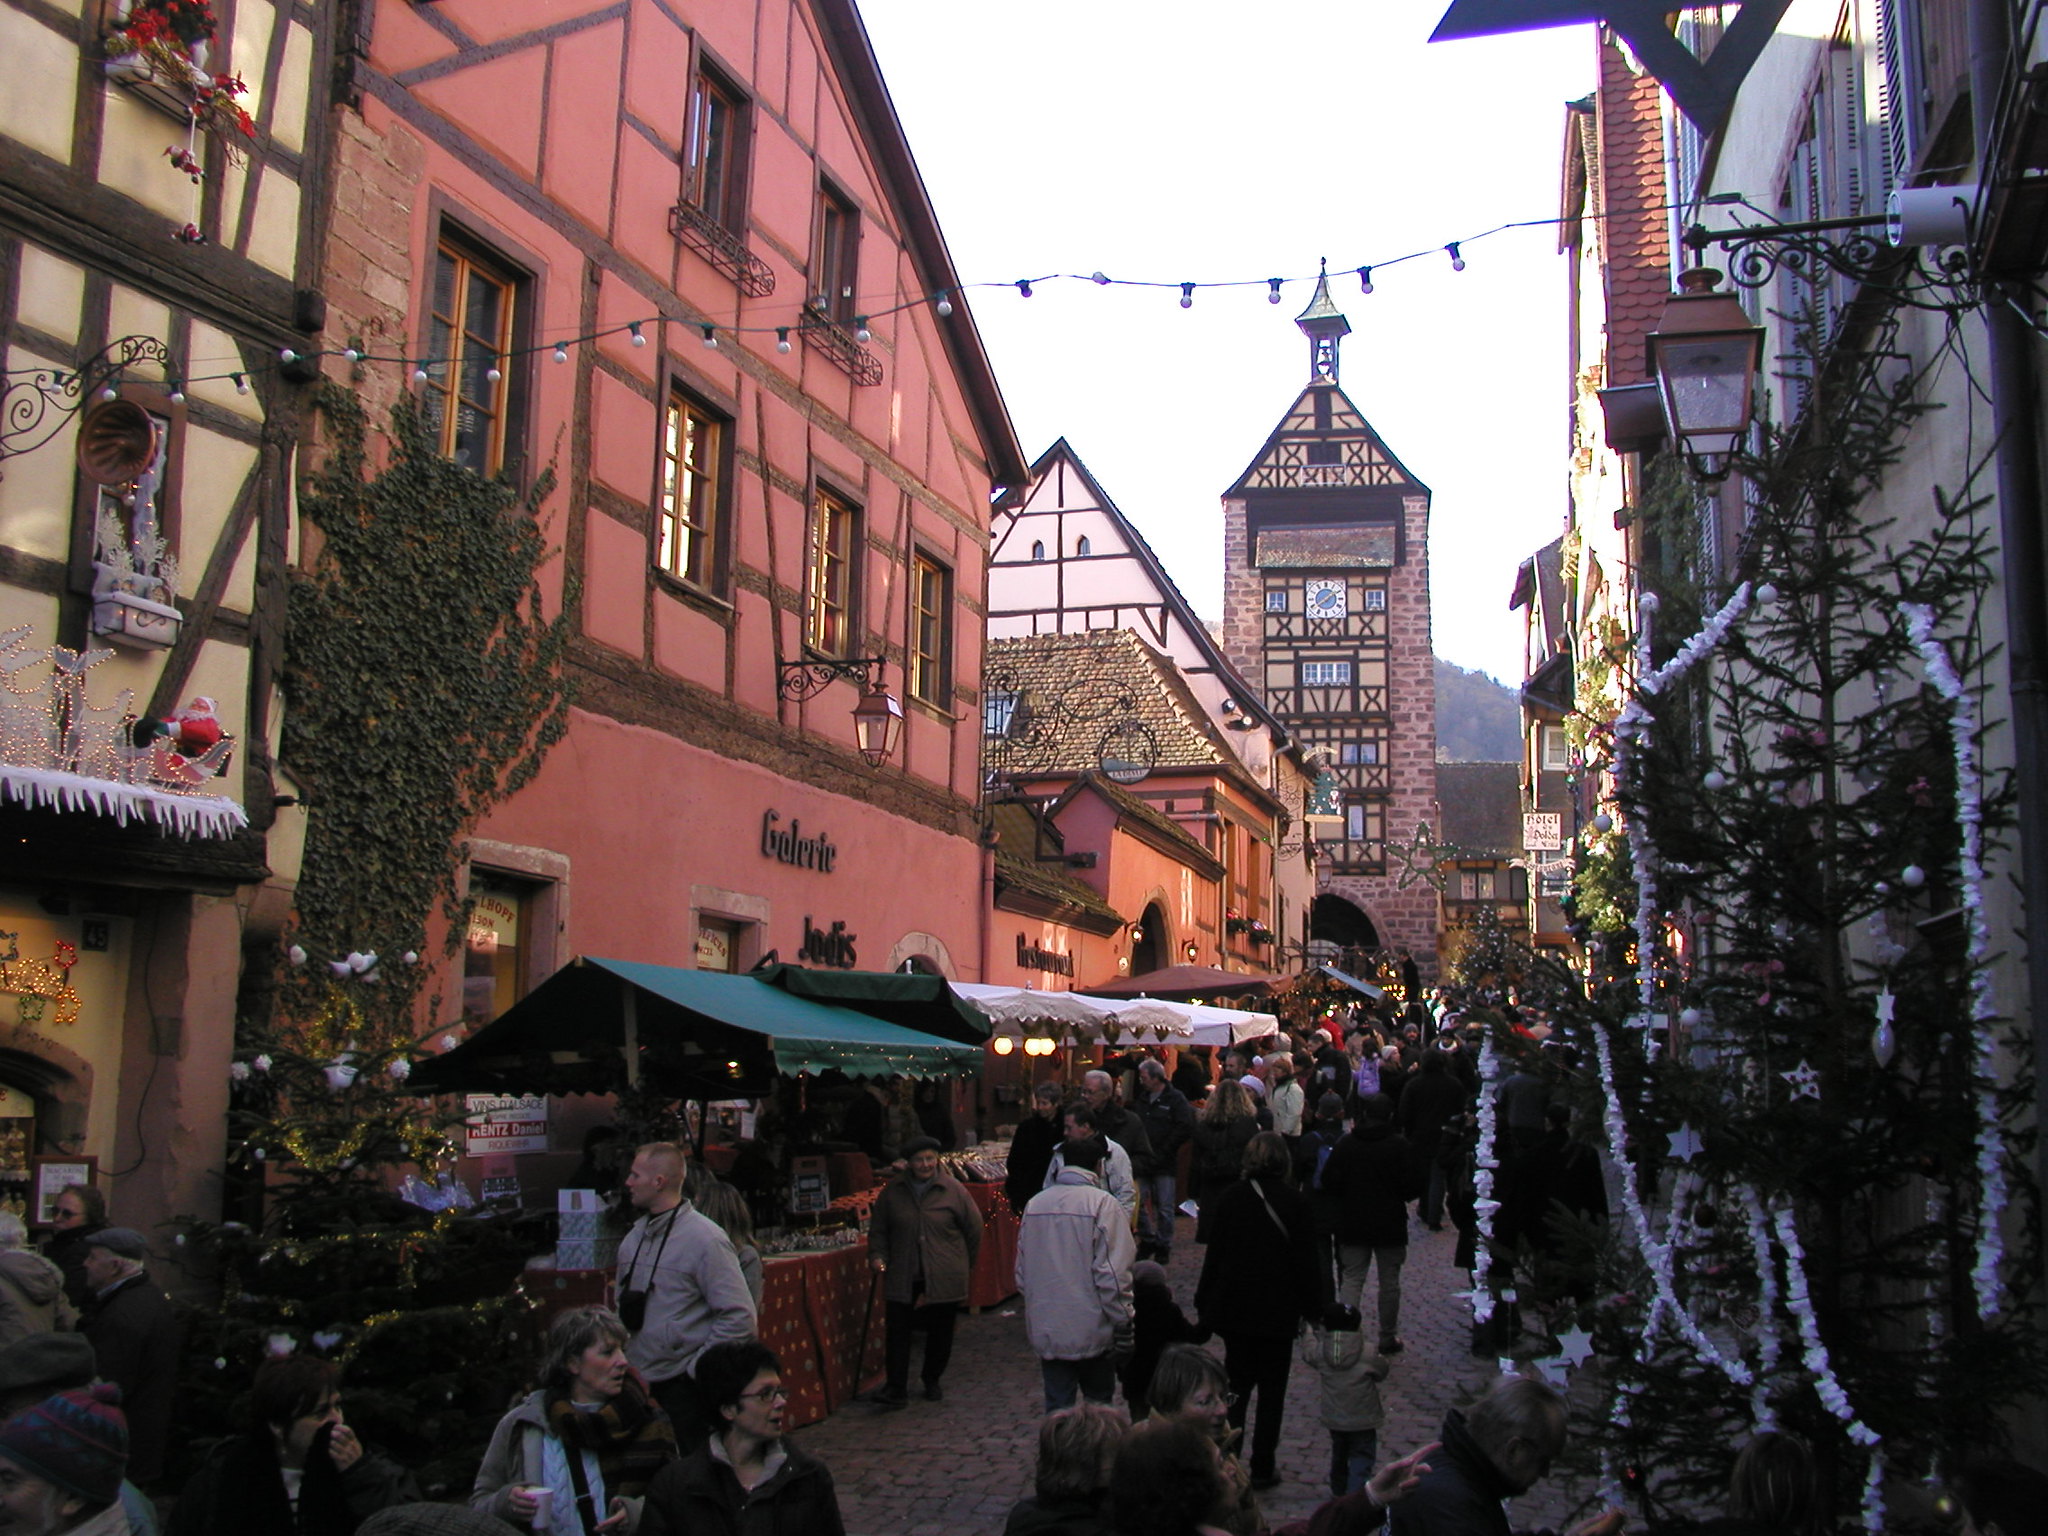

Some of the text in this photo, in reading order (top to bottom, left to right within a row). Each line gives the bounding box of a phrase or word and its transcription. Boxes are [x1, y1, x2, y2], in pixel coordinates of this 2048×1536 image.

[761, 808, 837, 873] Galerie
[472, 1100, 497, 1112] VINS
[512, 1121, 544, 1135] Daniel
